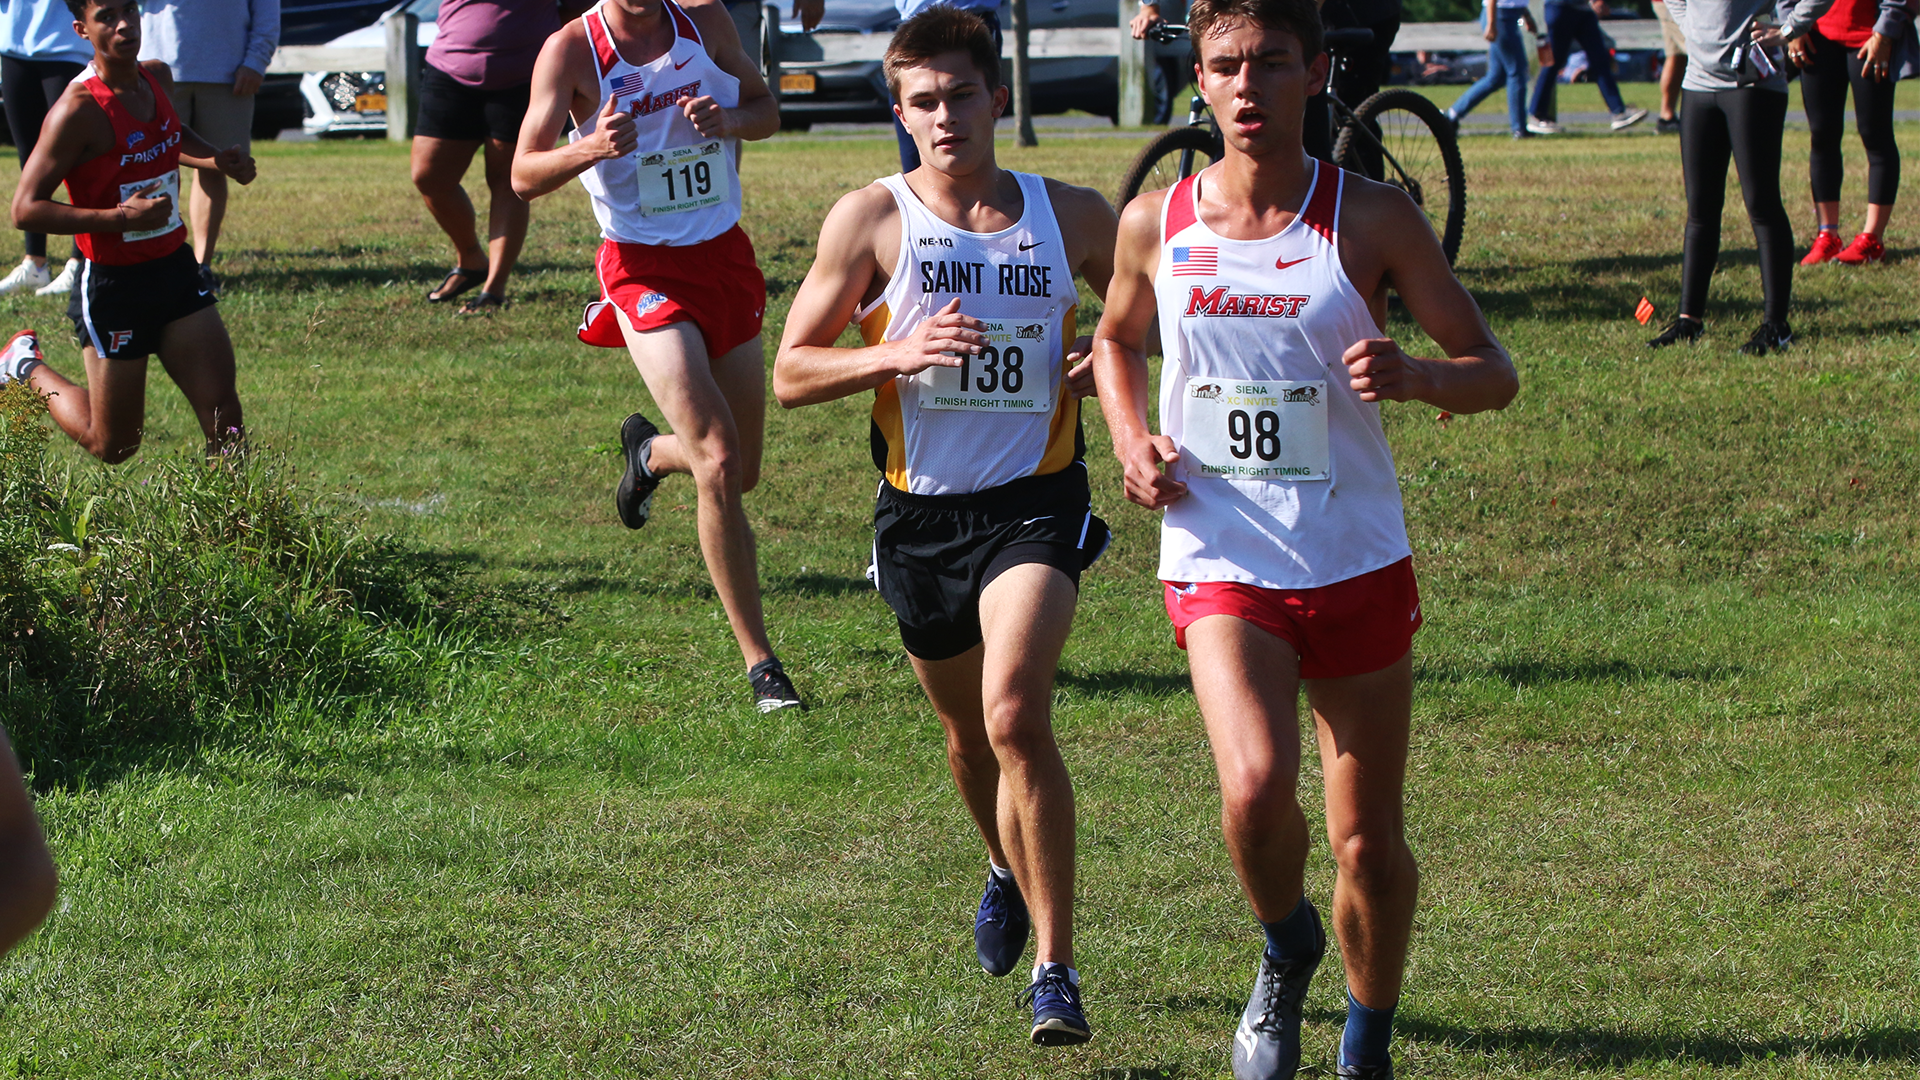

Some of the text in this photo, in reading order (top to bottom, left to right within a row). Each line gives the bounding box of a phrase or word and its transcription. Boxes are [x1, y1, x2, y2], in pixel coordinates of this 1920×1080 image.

[630, 80, 702, 119] MARIST
[672, 148, 692, 157] SIENA
[661, 160, 711, 201] 119
[653, 195, 721, 213] FINISH RIGHT TIMING
[919, 237, 953, 247] NE-10
[921, 261, 1052, 298] SAINT ROSE
[1183, 285, 1311, 318] MARIST
[108, 330, 133, 353] F
[955, 345, 1024, 394] 138
[1235, 385, 1268, 395] SIENA
[934, 397, 1034, 408] FINISH RIGHT TIMING
[1227, 396, 1278, 406] XC INVITE
[1228, 409, 1281, 461] 98
[1201, 464, 1311, 476] FINISH RIGHT TIMING
